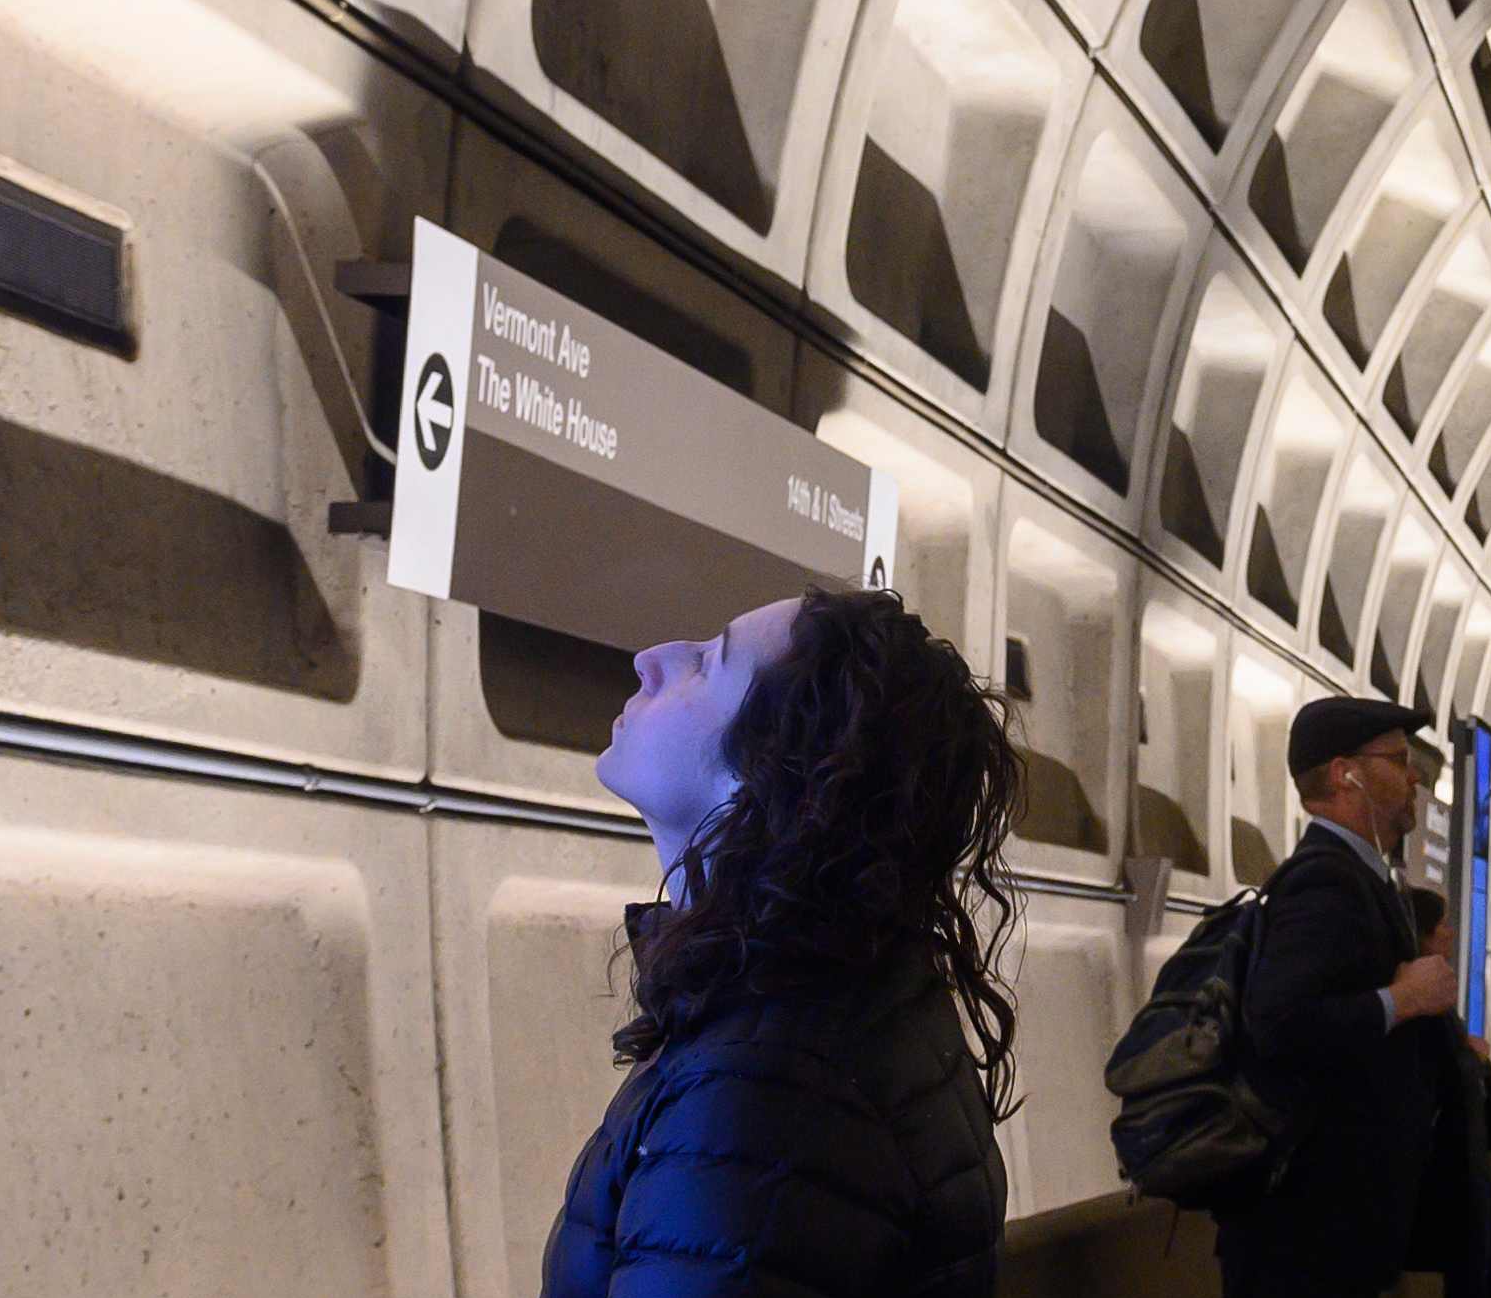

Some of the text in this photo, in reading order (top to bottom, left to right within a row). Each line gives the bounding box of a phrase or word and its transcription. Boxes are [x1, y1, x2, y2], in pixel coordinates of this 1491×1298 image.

[483, 282, 590, 378] Vermont Ave
[477, 354, 617, 459] The White House
